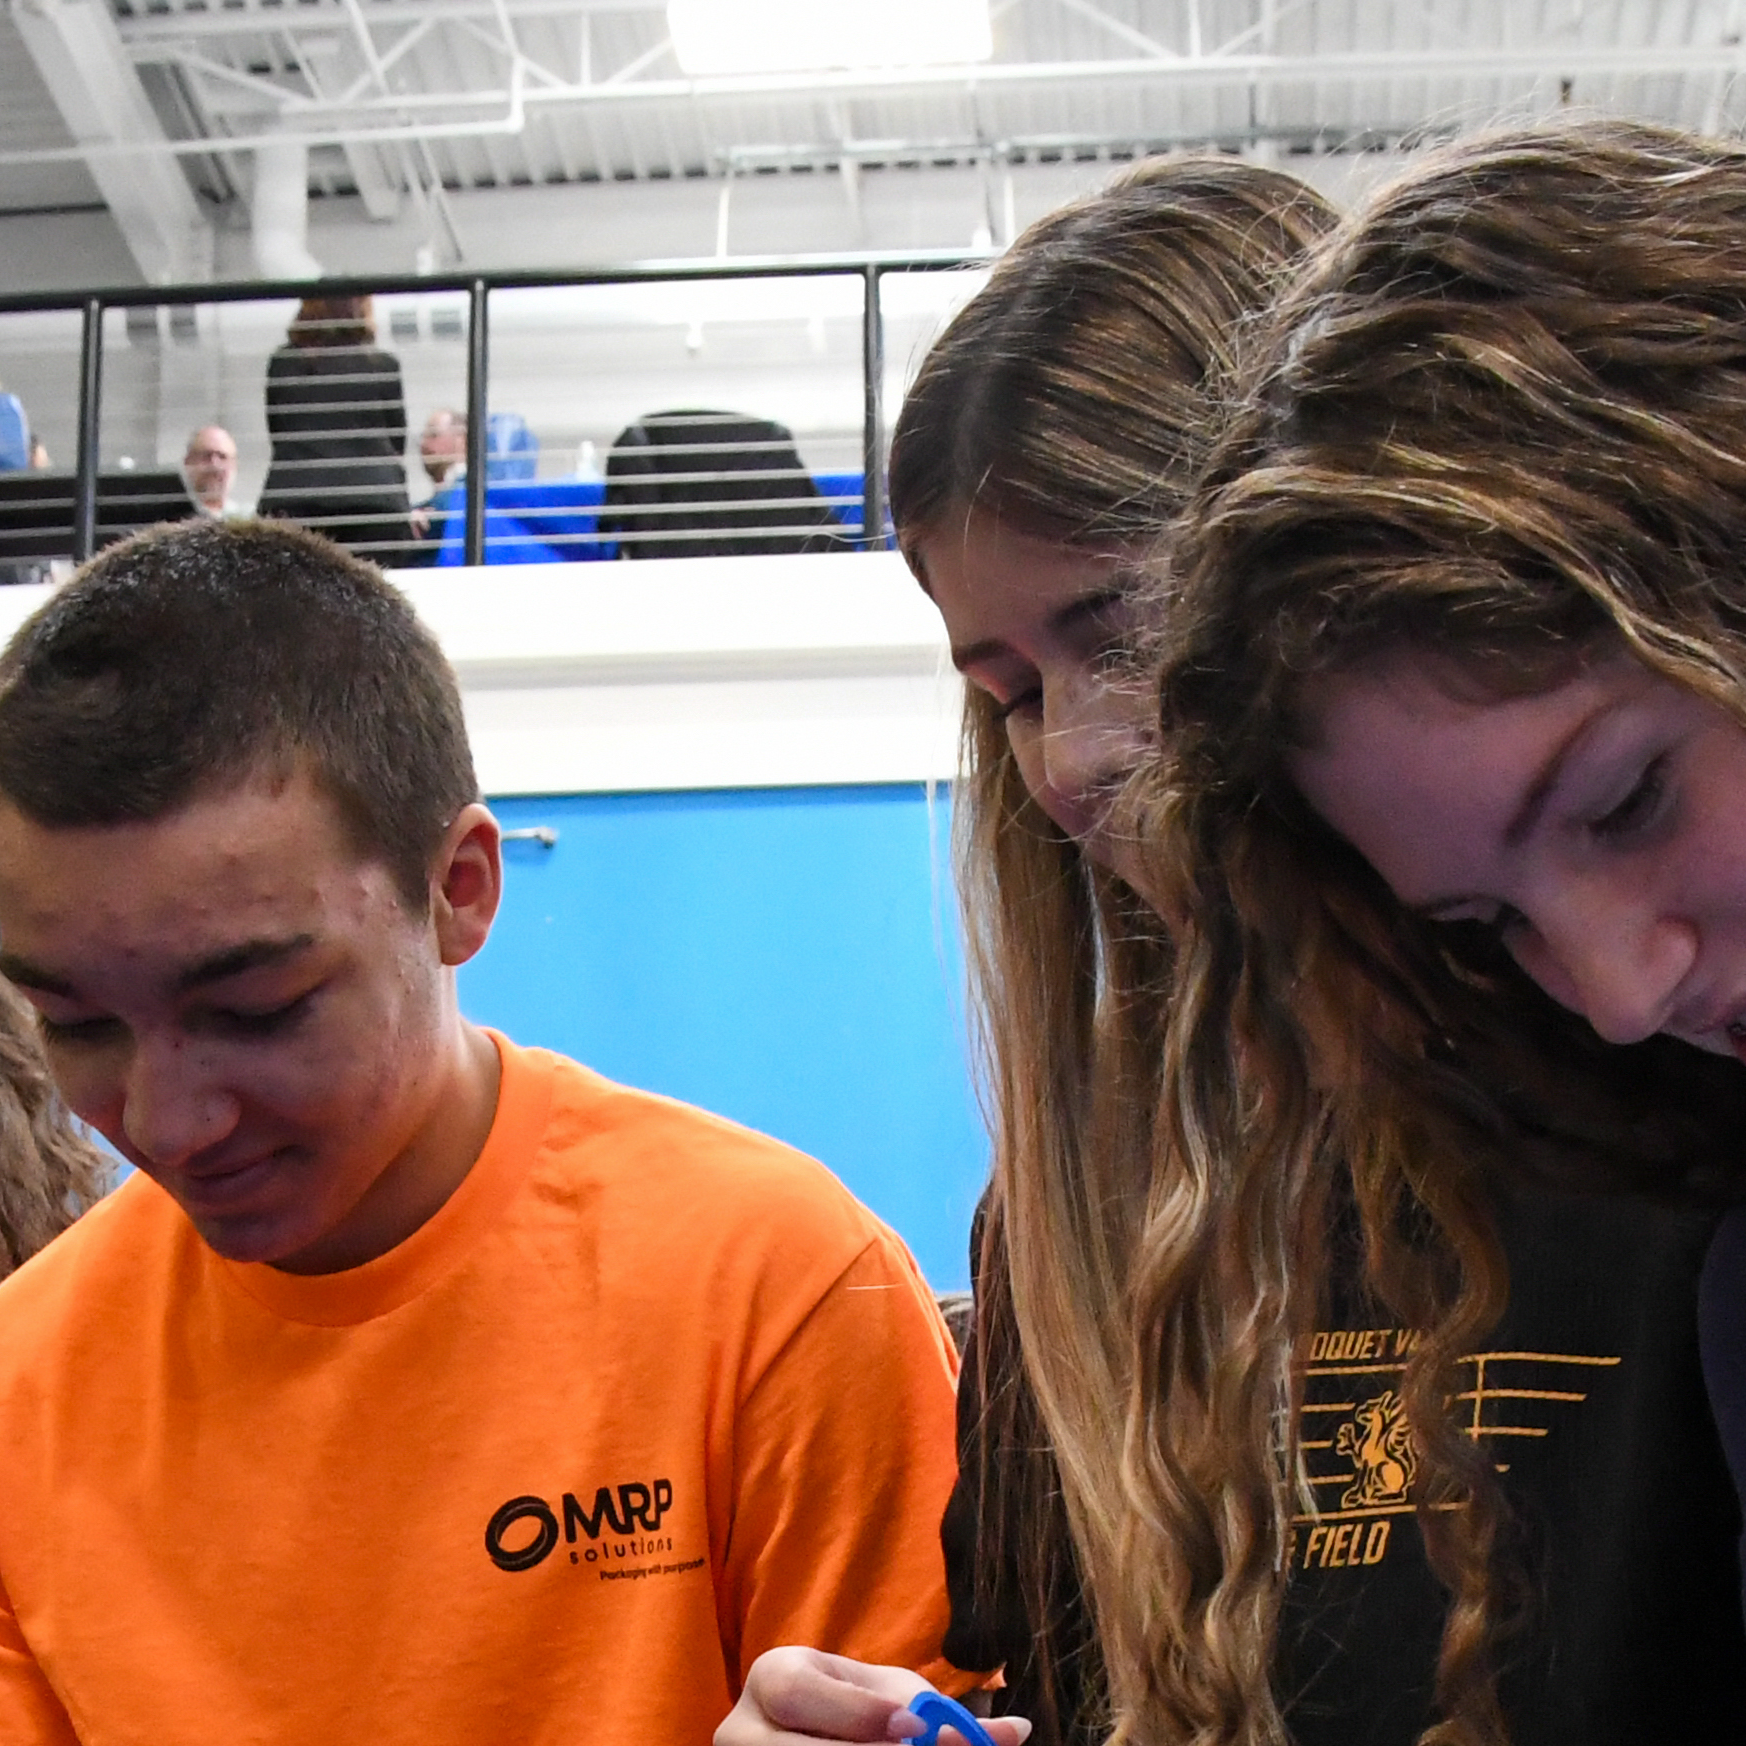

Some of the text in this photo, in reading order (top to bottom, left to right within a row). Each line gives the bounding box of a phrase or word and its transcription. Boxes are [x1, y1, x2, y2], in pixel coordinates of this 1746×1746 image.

[1309, 1329, 1393, 1361] OQUET
[569, 1537, 673, 1565] solutions
[1303, 1520, 1392, 1569] FIELD
